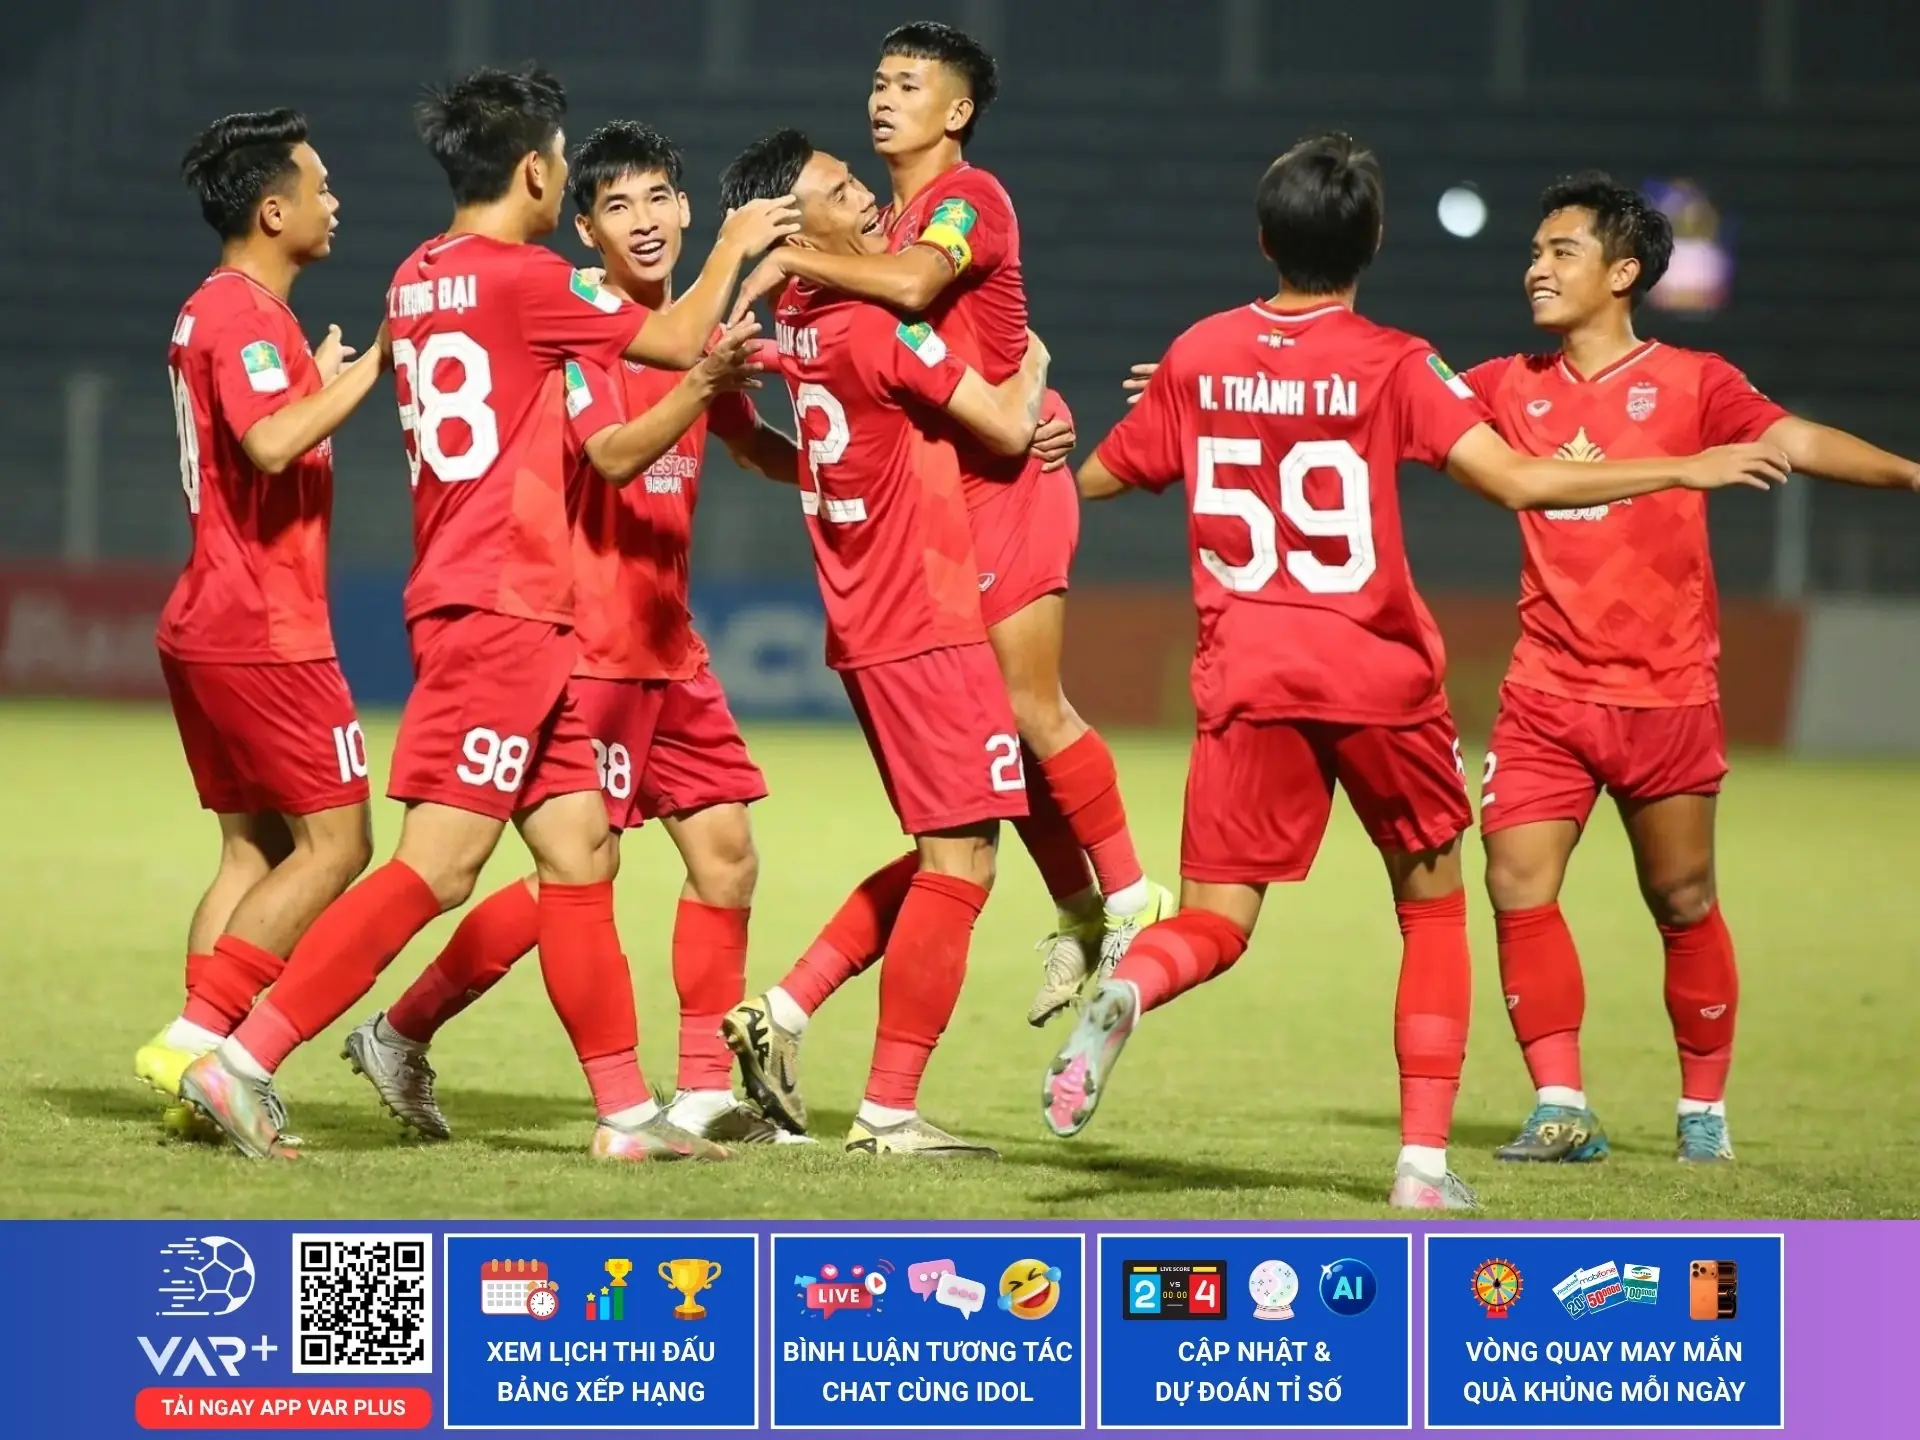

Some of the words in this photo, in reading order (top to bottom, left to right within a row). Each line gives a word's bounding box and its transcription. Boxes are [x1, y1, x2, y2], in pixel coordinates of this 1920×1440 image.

[438, 274, 477, 315] ĐẠI
[392, 331, 500, 486] 98
[1198, 375, 1218, 410] N.
[1222, 371, 1305, 416] THÀNH
[1313, 373, 1357, 417] TÀI
[1193, 436, 1377, 594] 59
[333, 720, 367, 783] 10
[456, 727, 530, 793] 98
[985, 732, 1026, 792] 2
